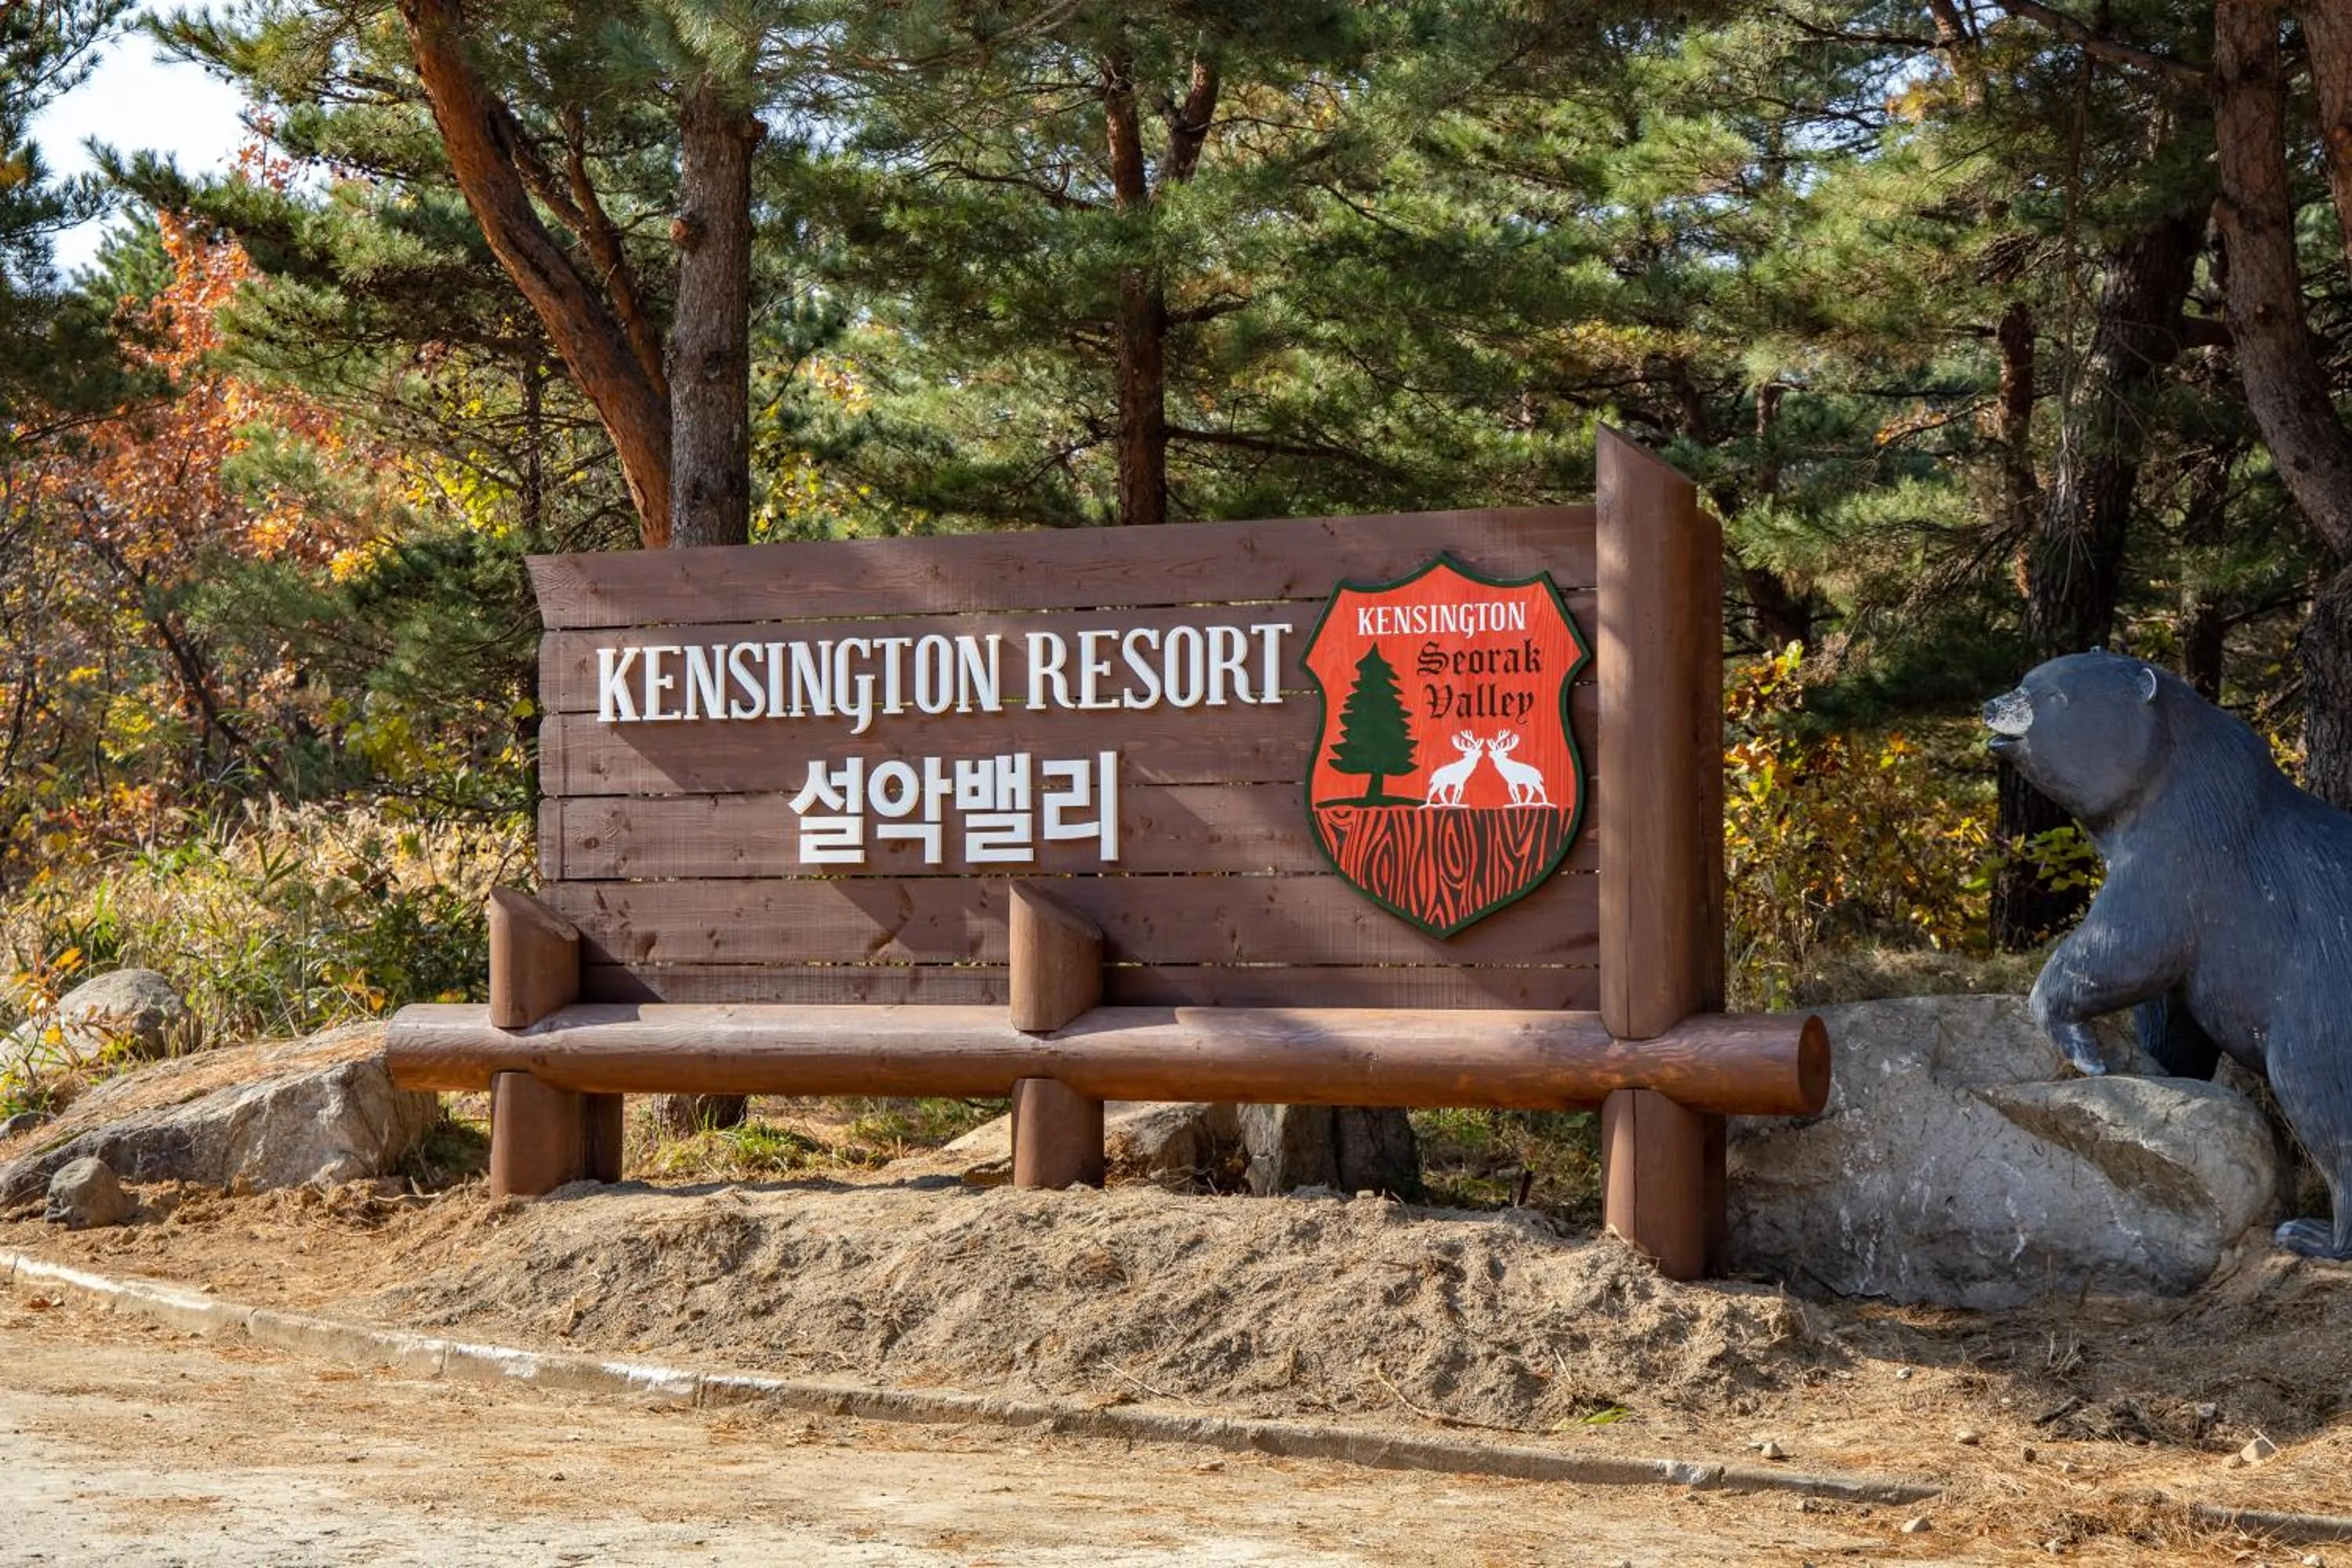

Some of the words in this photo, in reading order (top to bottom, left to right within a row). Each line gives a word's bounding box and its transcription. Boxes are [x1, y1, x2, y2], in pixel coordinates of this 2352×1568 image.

[1357, 601, 1526, 639] KENSINGTON
[596, 633, 1003, 735] KENSINGTON
[1025, 622, 1293, 710] RESORT
[1417, 639, 1543, 677] Seorak
[1424, 683, 1534, 724] Valley
[788, 750, 1118, 864] 설악밸리
